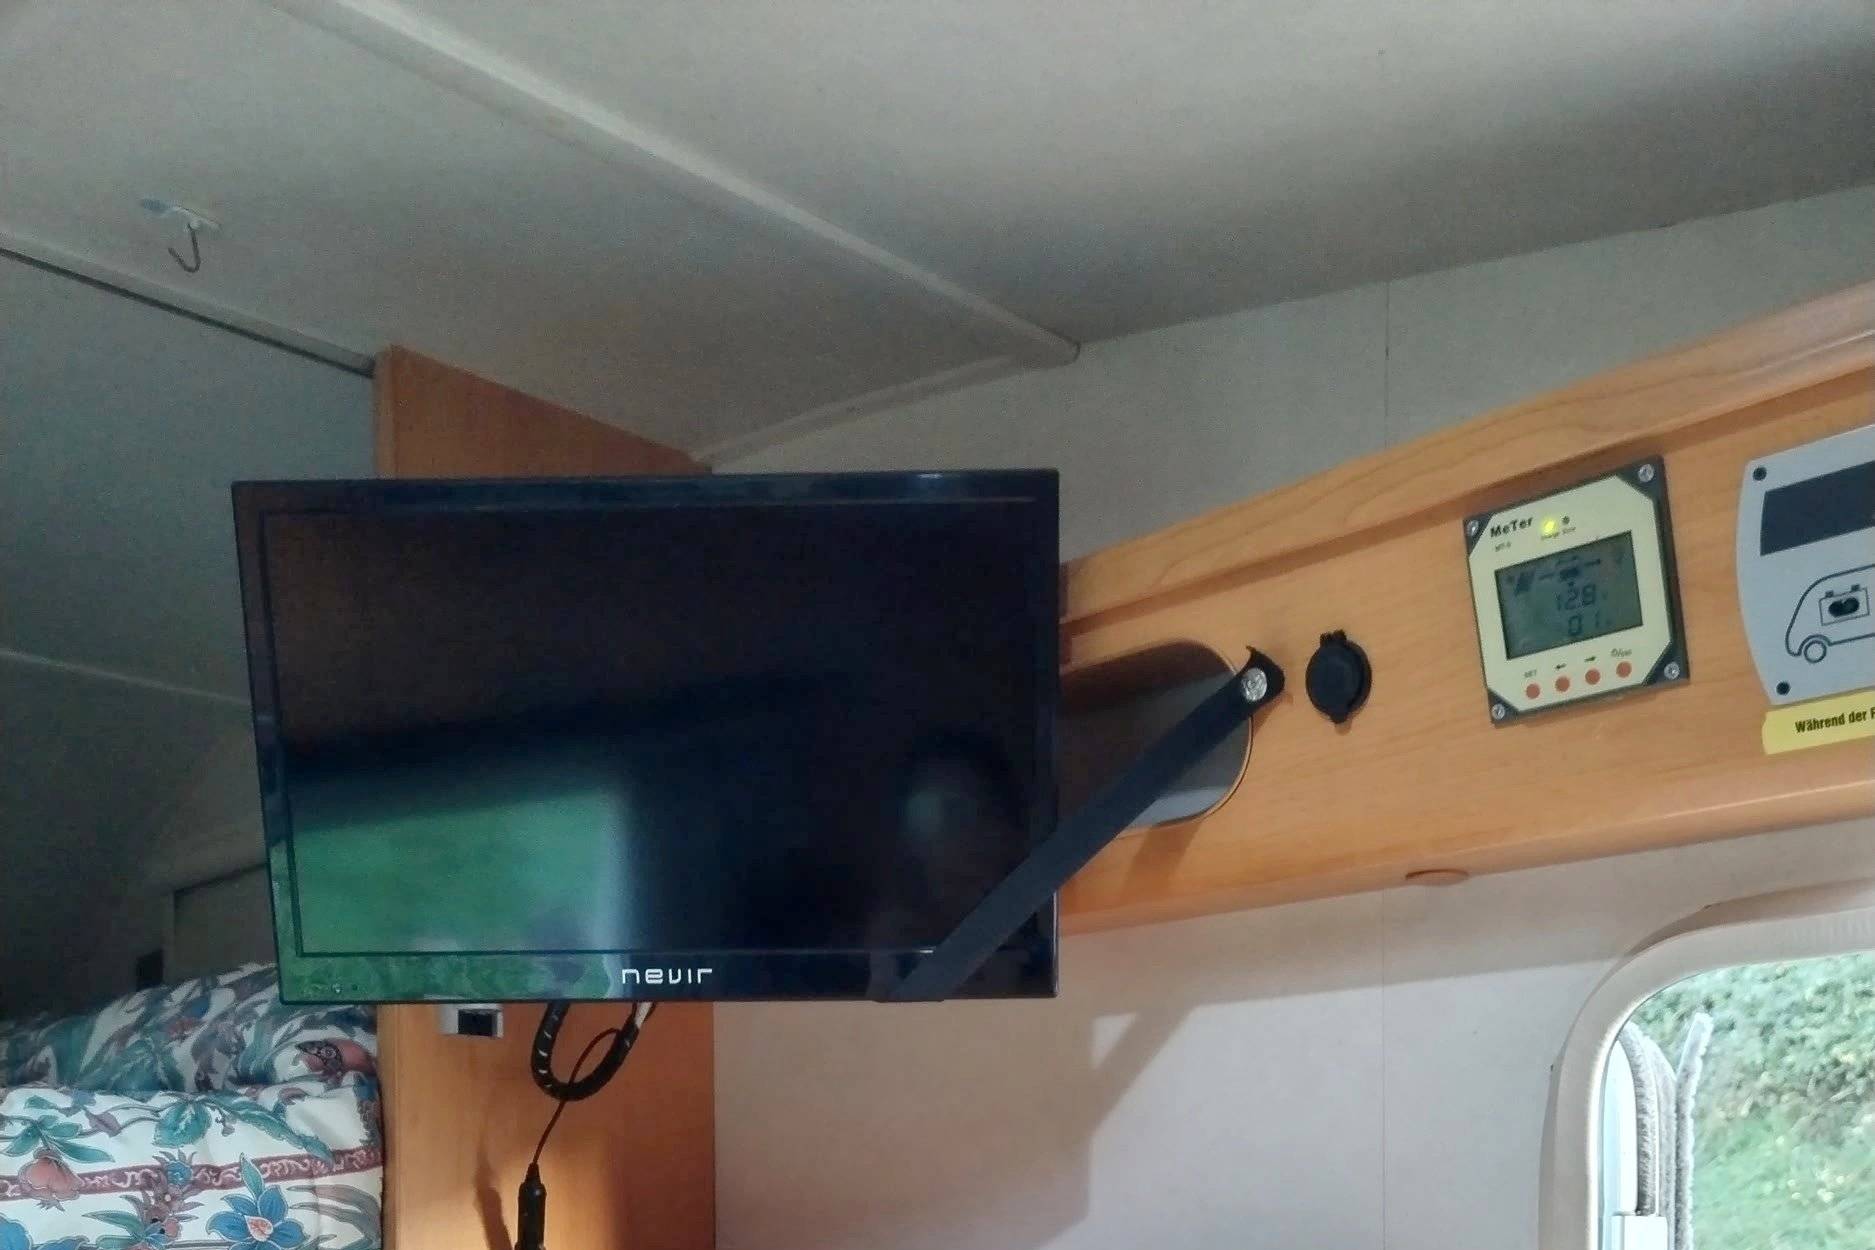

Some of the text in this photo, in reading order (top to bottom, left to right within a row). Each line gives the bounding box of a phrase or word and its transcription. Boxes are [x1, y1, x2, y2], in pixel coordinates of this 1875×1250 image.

[1794, 713, 1846, 733] Während
[1848, 711, 1867, 723] der
[621, 968, 713, 984] nevir
